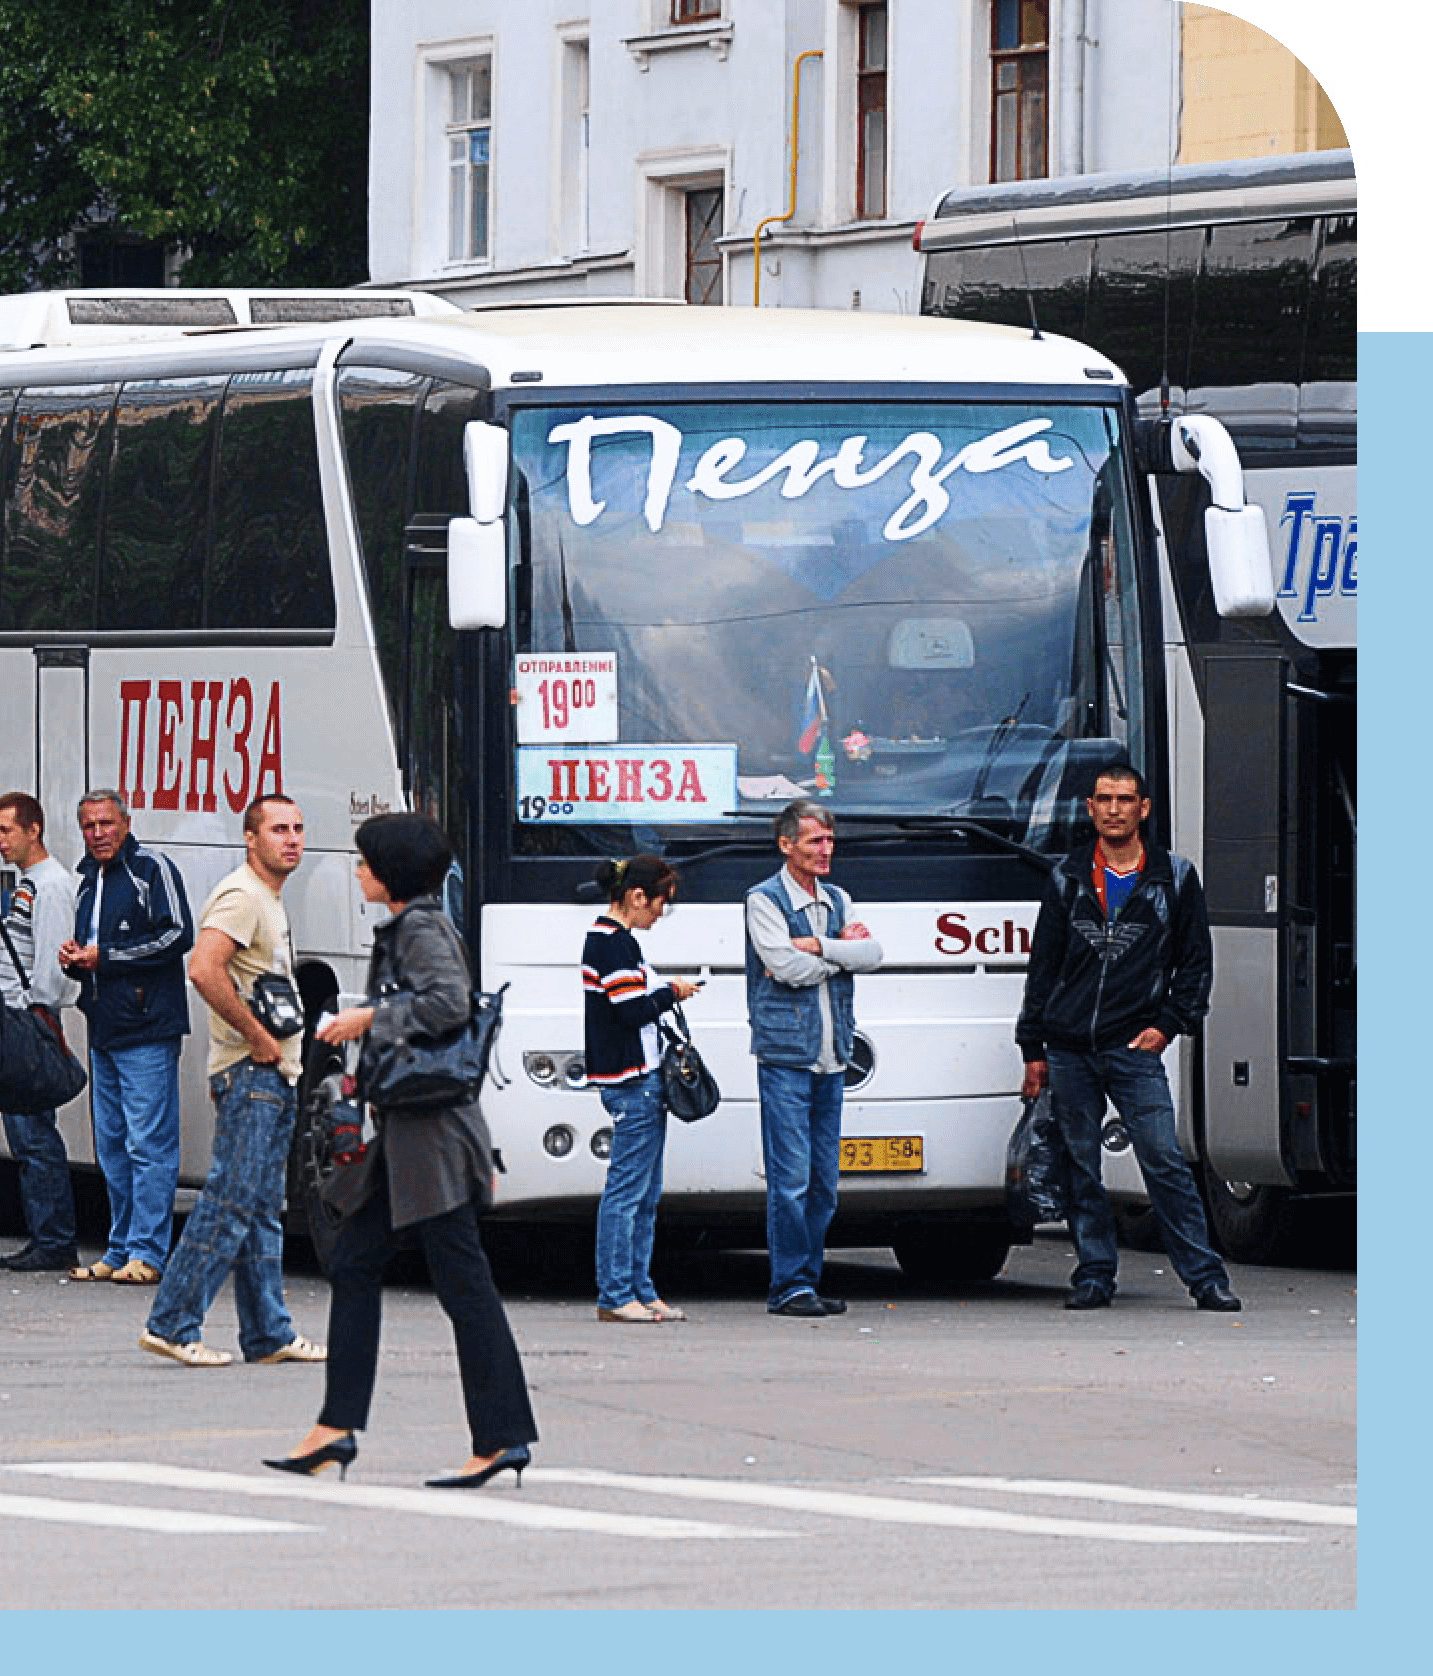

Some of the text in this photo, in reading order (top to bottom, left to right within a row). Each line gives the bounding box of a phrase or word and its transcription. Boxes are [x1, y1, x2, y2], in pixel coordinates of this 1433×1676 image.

[549, 414, 1075, 541] Пенза
[519, 660, 614, 674] ОТПРАВЛЕНИЕ
[119, 675, 284, 815] ПЕНЗА
[547, 759, 707, 803] ПЕНЗА
